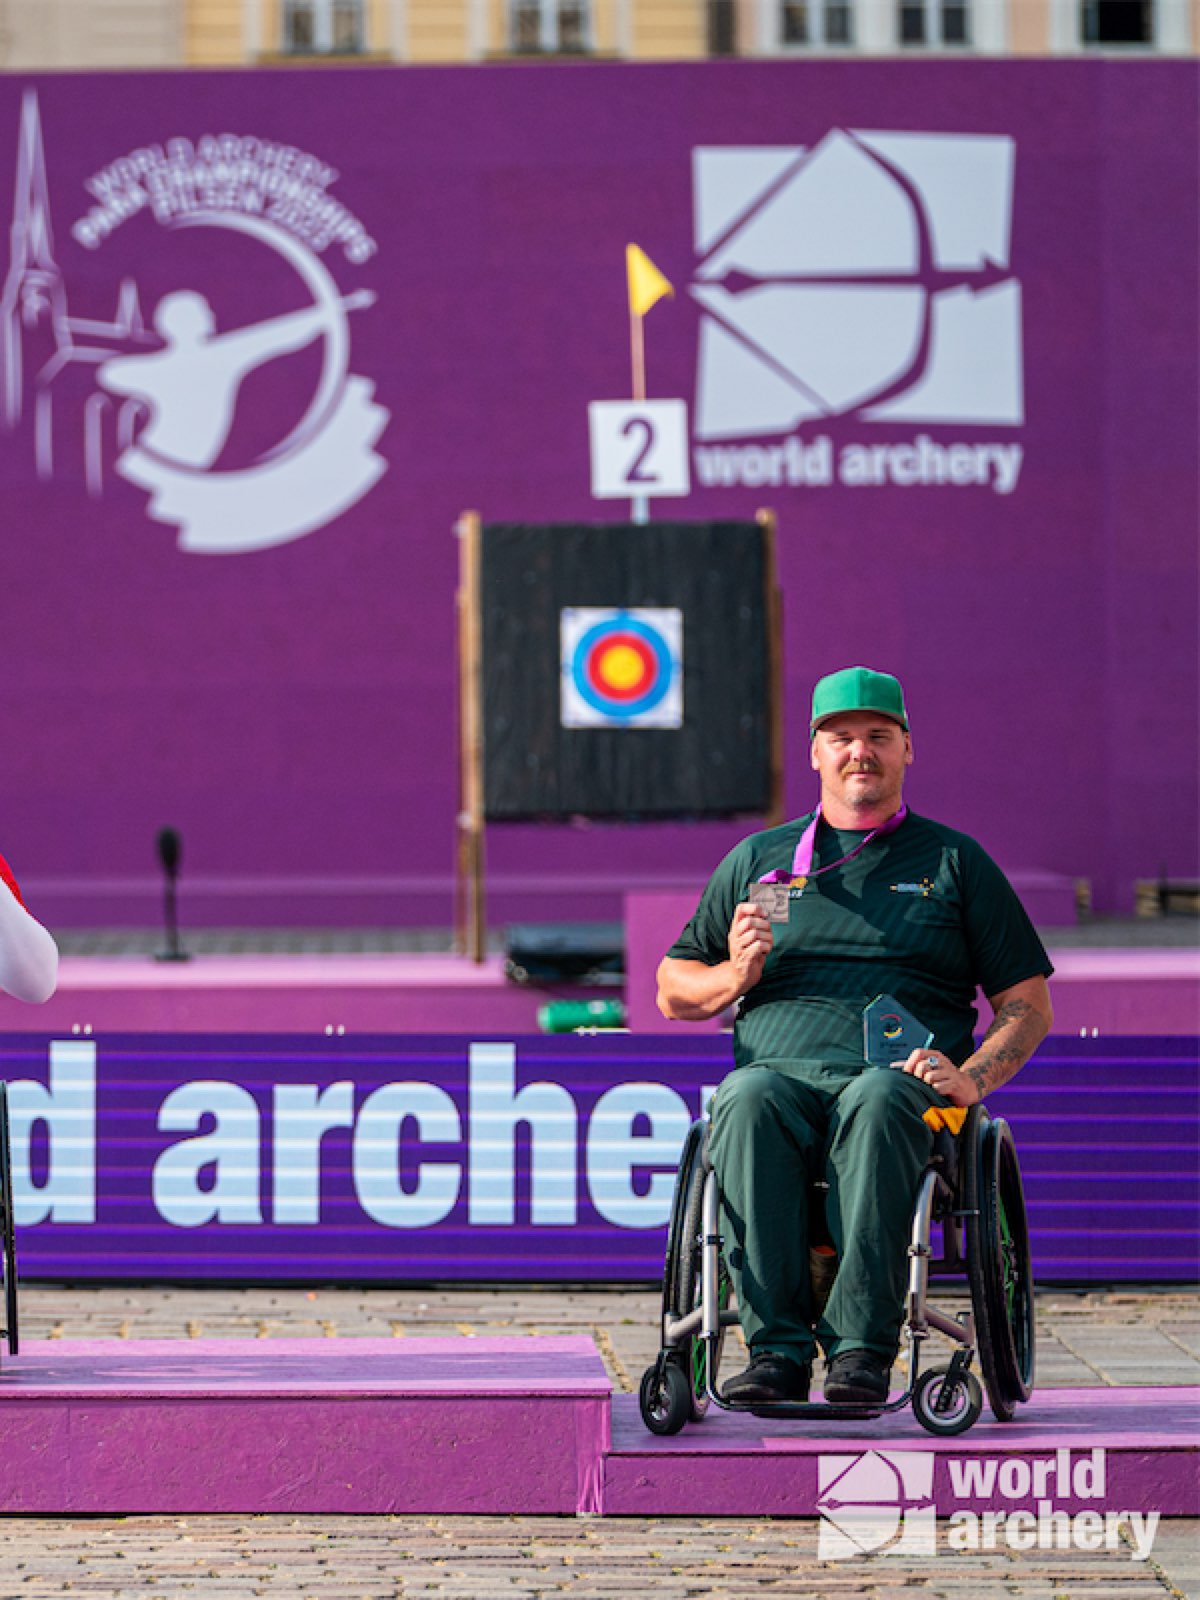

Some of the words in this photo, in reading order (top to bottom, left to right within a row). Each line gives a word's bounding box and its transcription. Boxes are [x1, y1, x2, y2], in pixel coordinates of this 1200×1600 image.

[84, 136, 195, 199] WORLD
[198, 133, 340, 188] ARCHERY
[154, 186, 262, 226] PILSEN
[621, 418, 659, 482] 2
[697, 435, 832, 487] world
[839, 434, 1022, 494] archery
[153, 1043, 718, 1228] arche
